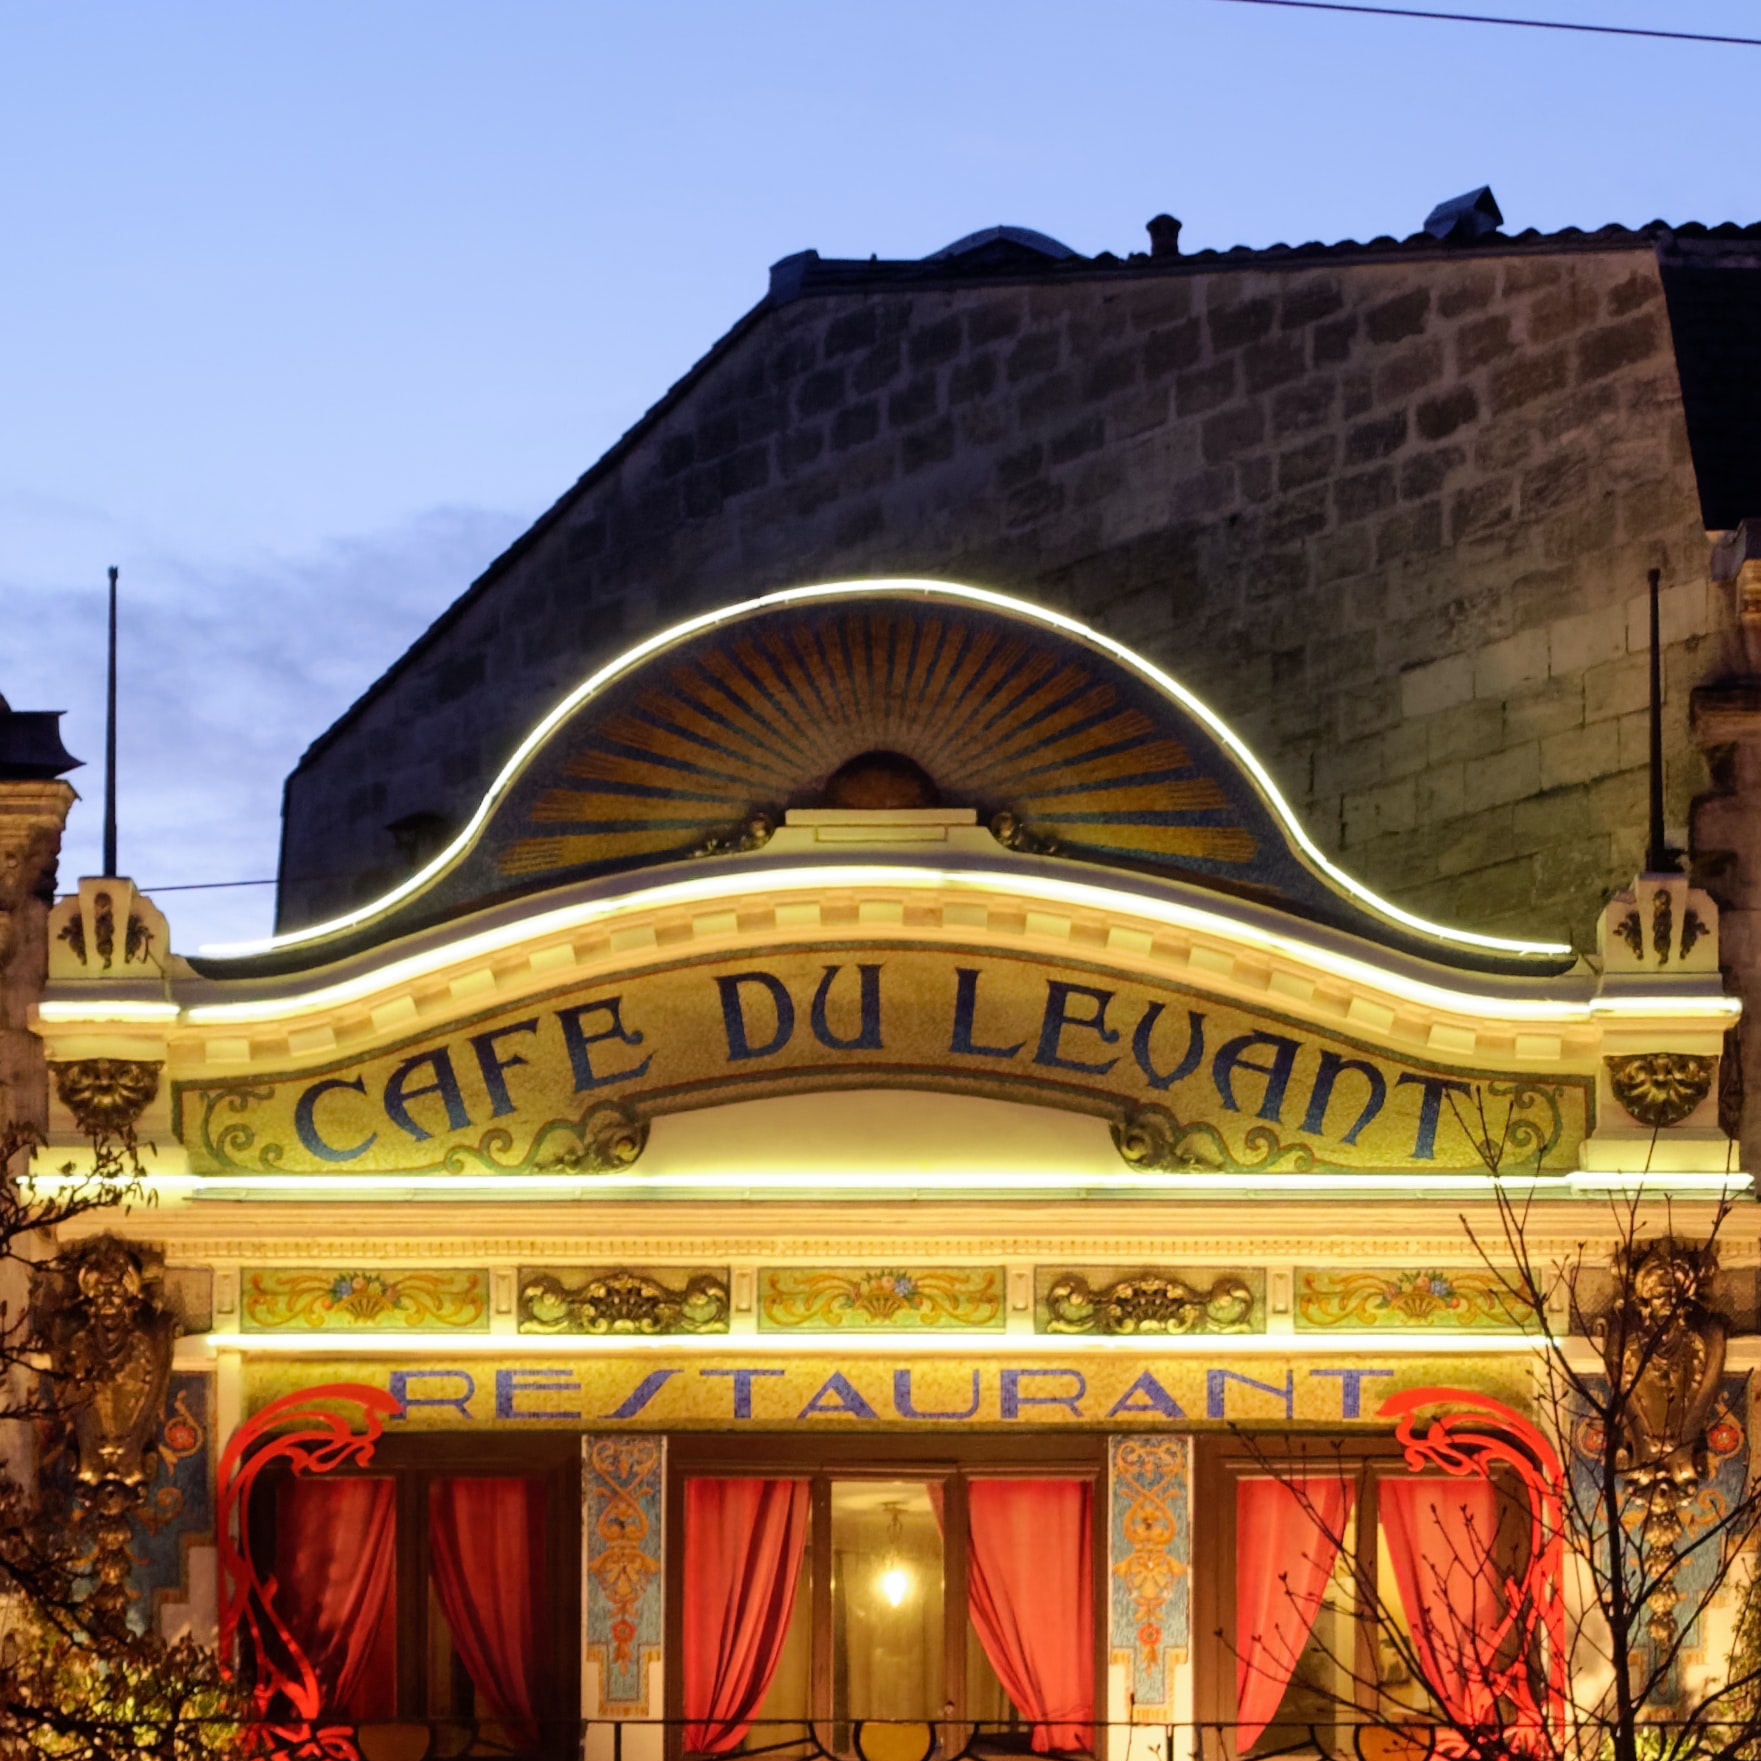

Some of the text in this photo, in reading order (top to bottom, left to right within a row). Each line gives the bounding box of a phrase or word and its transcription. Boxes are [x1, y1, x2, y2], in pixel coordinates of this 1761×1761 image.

[715, 963, 883, 1063] DU
[948, 967, 1475, 1162] LEVANT
[389, 1367, 1396, 1423] RESTAURANT
